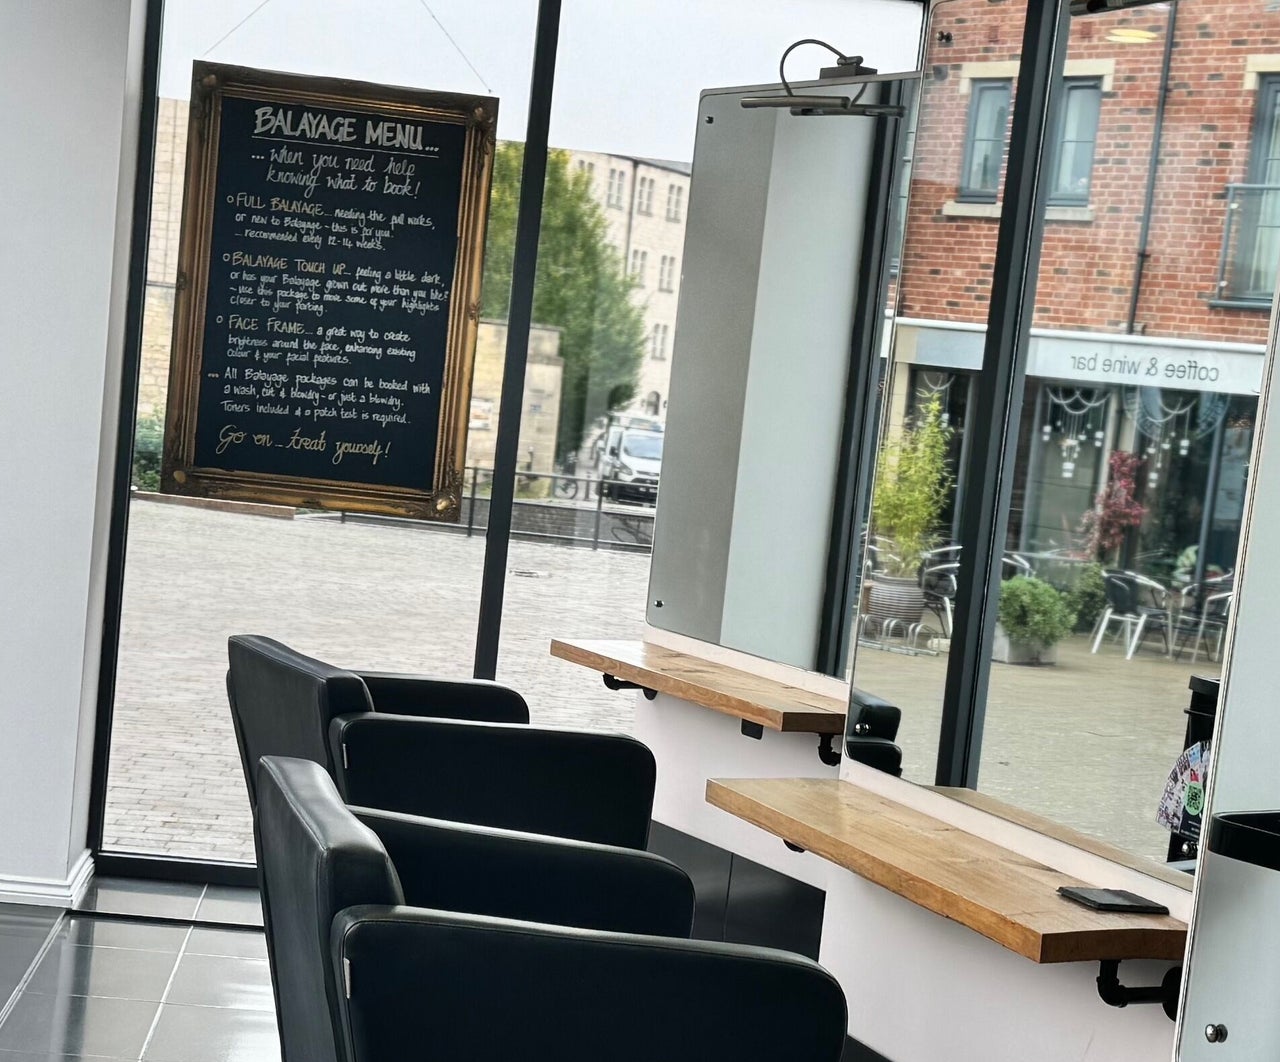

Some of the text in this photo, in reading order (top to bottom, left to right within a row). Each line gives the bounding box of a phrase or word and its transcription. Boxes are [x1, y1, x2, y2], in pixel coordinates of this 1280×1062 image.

[254, 106, 357, 142] BALAYAGE
[310, 153, 340, 178] you
[345, 154, 375, 172] need
[383, 156, 416, 179] help
[266, 163, 320, 199] knowing
[325, 173, 358, 190] what
[361, 176, 378, 192] to
[236, 192, 266, 209] FULL
[334, 208, 366, 228] needing
[367, 210, 387, 222] the
[389, 213, 405, 231] full
[235, 213, 246, 223] or
[271, 215, 281, 226] to
[283, 217, 322, 236] Balayage
[331, 222, 348, 233] this
[351, 225, 359, 234] is
[360, 227, 374, 243] for
[302, 234, 322, 250] every
[231, 251, 288, 270] BALAYAGE
[294, 259, 325, 274] TOUCH
[355, 266, 382, 285] feeling
[384, 271, 392, 280] a
[394, 268, 417, 282] little
[230, 271, 240, 280] or
[242, 270, 257, 281] has
[260, 275, 278, 289] your
[282, 273, 322, 292] Balayage
[324, 279, 349, 294] grown
[352, 282, 368, 292] out
[370, 284, 391, 295] more
[392, 284, 410, 297] than
[412, 290, 427, 304] you
[260, 298, 270, 307] to
[272, 301, 291, 313] your
[277, 288, 309, 304] package
[311, 291, 321, 301] to
[345, 295, 368, 304] some
[369, 298, 378, 310] of
[378, 299, 397, 312] your
[401, 297, 440, 316] highlights
[228, 314, 259, 331] FACE
[316, 326, 323, 336] a
[325, 326, 347, 342] great
[349, 329, 366, 344] way
[368, 328, 380, 339] to
[383, 330, 411, 342] create
[263, 351, 283, 363] your
[286, 351, 309, 366] facial
[272, 338, 298, 349] around
[303, 339, 317, 350] the
[345, 342, 383, 360] enhancing
[386, 347, 416, 363] existing
[224, 366, 431, 394] All Balayage packages can be booked with
[223, 384, 231, 394] a
[261, 386, 276, 397] cut
[327, 392, 338, 401] or
[337, 391, 357, 407] just
[359, 395, 366, 403] a
[220, 400, 251, 413] Toners
[256, 402, 289, 415] included
[304, 409, 311, 417] a
[314, 406, 337, 422] patch
[340, 407, 358, 419] test
[361, 410, 369, 420] is
[215, 424, 247, 454] Go
[285, 427, 327, 451] treat
[332, 440, 391, 465] yourself!
